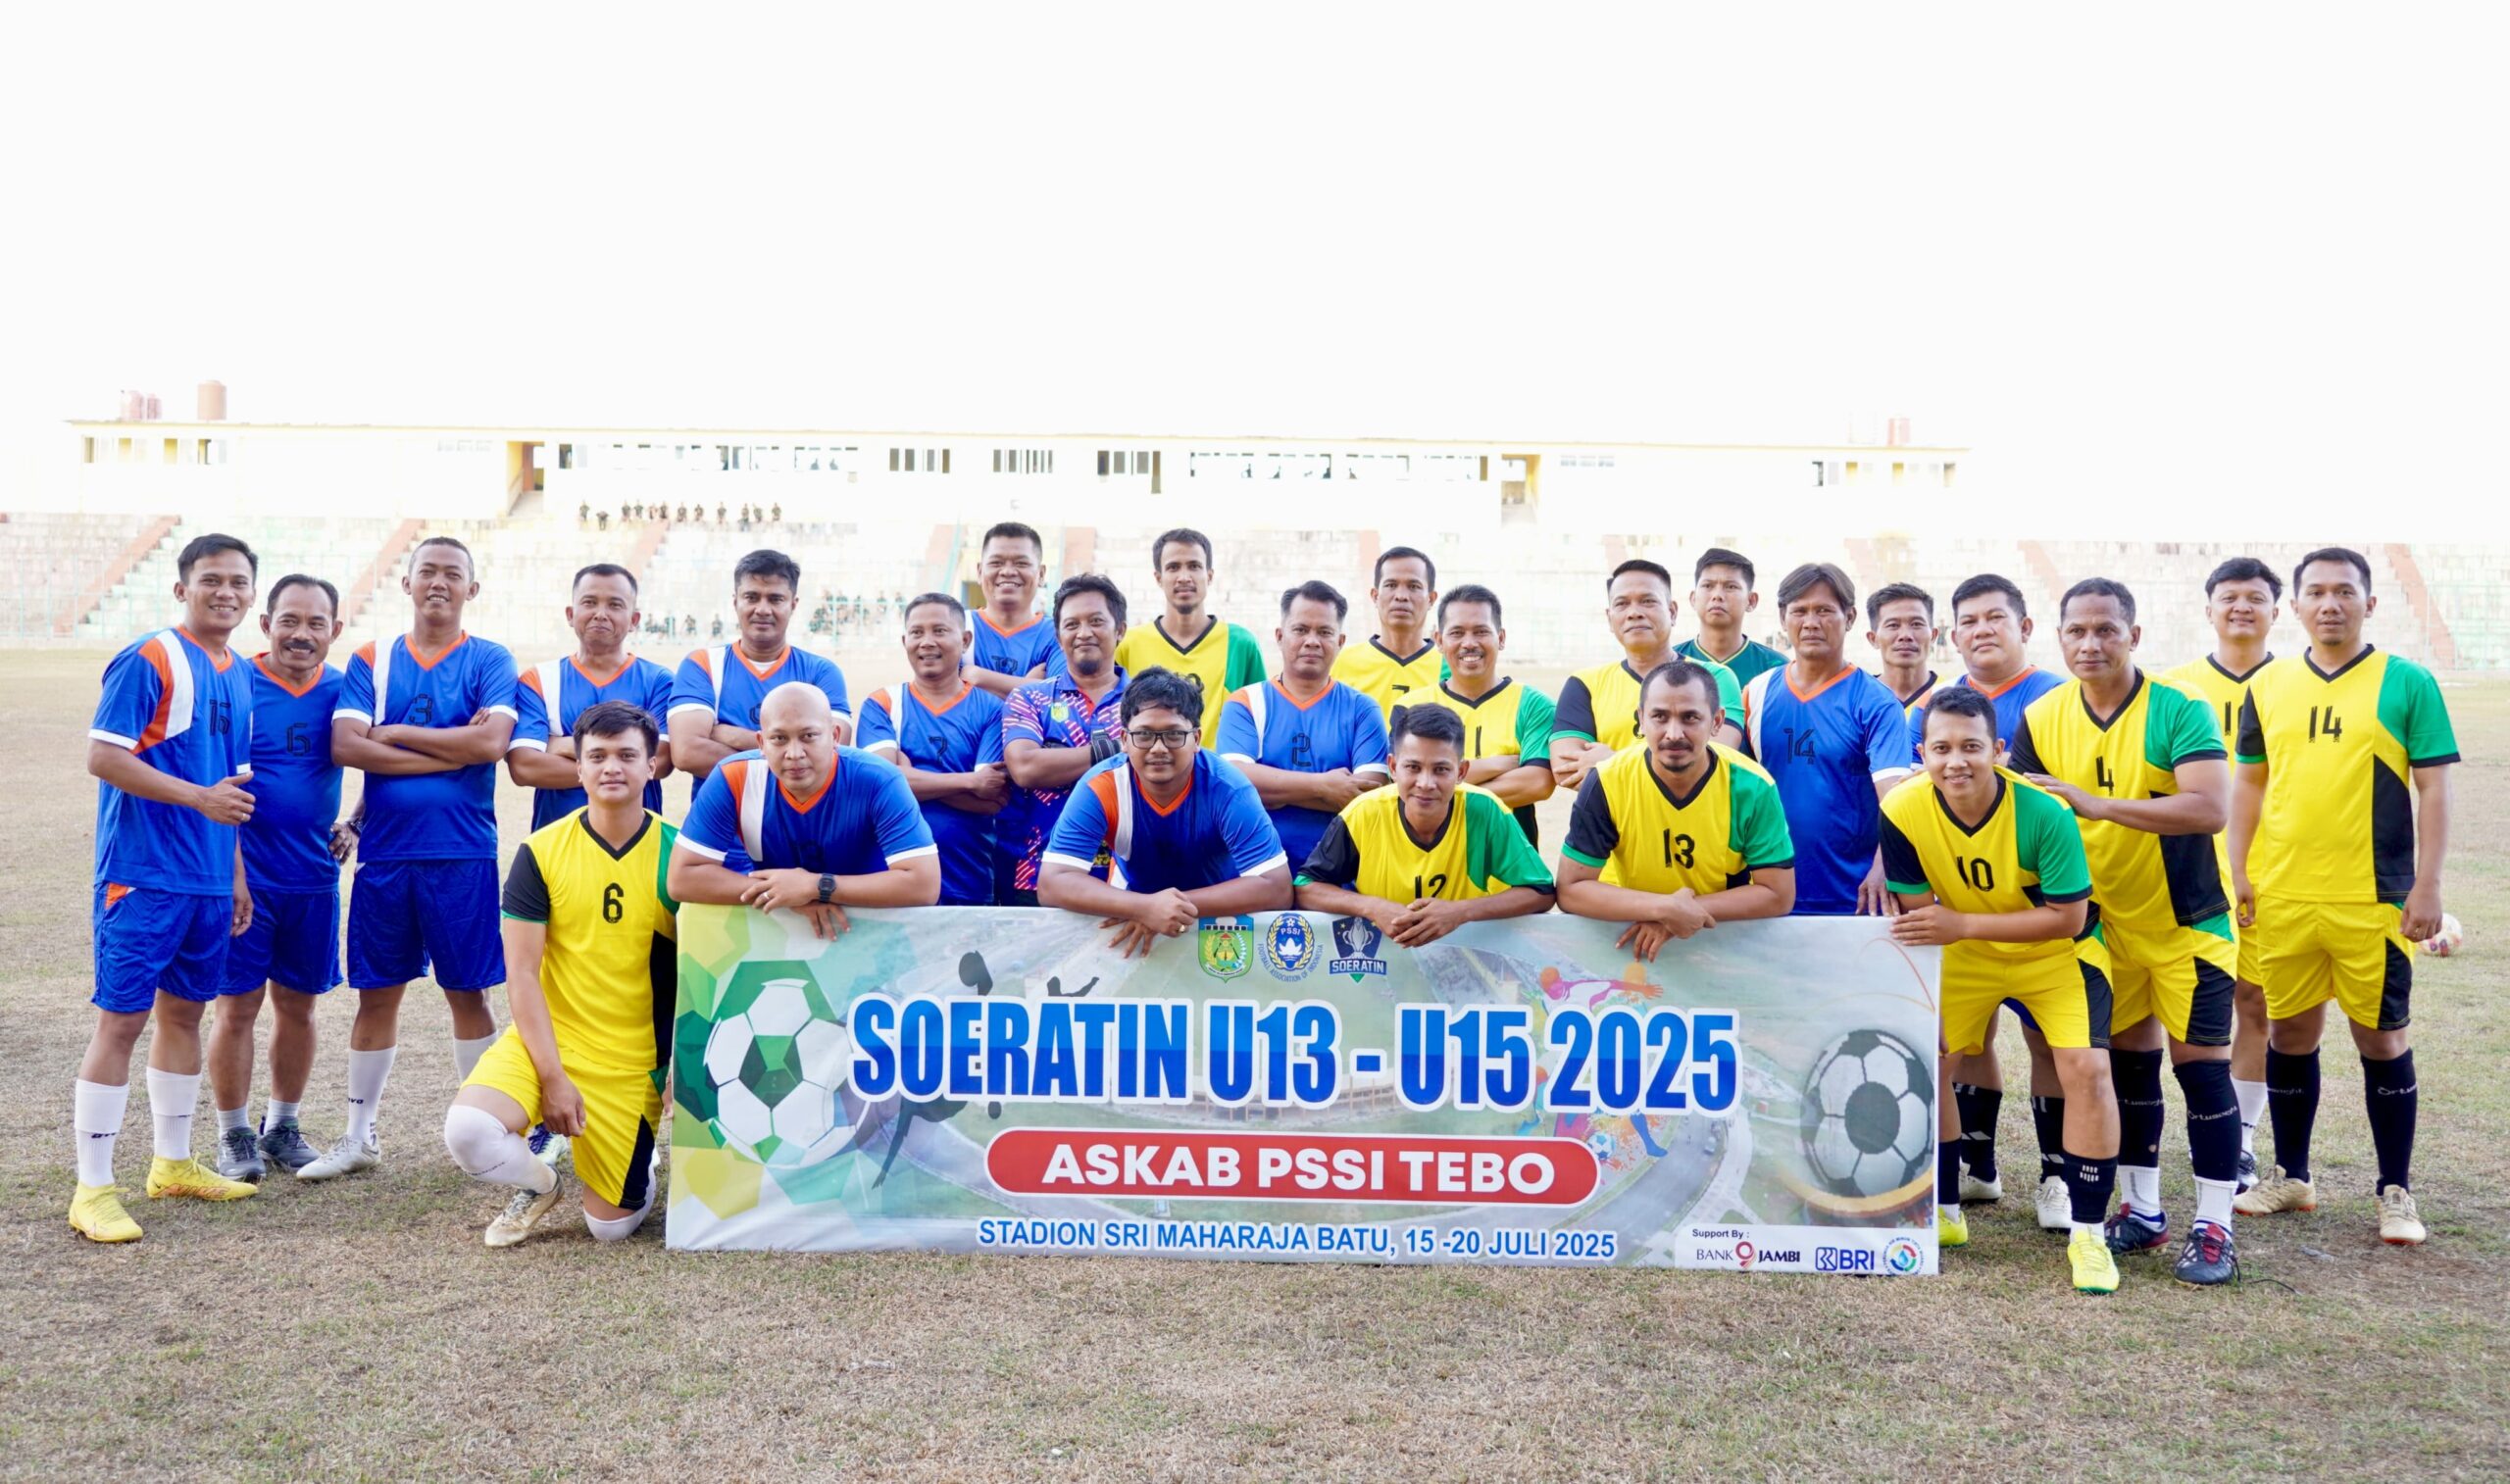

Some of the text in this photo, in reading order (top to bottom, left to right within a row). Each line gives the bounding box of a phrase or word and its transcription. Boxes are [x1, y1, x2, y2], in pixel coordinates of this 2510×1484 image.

[410, 693, 432, 726] 3
[2224, 700, 2244, 737] 1
[2308, 705, 2342, 744] 14
[286, 722, 310, 756] 6
[929, 735, 948, 763] 7
[1291, 732, 1312, 767] 2
[1782, 727, 1817, 766] 14
[2095, 755, 2115, 797] 4
[1663, 828, 1695, 869] 13
[1414, 873, 1446, 899] 12
[1956, 855, 1995, 893] 10
[603, 881, 625, 924] 6
[1280, 926, 1300, 936] PSSI
[1332, 961, 1384, 974] SOERATIN
[853, 999, 1736, 1112] SOERATIN U13 - U15 2025
[1041, 1143, 1555, 1194] ASKAB PSSI TEBO
[979, 1219, 1095, 1246] STADION
[1104, 1223, 1147, 1247] SRI
[1157, 1225, 1309, 1250] MAHARAJA
[1317, 1227, 1396, 1257] BATU,
[1405, 1229, 1433, 1253] 15
[1488, 1231, 1546, 1256] JULI
[1555, 1233, 1615, 1258] 2025
[1692, 1228, 1729, 1239] Support
[1732, 1229, 1743, 1239] By
[1696, 1249, 1733, 1261] BANK
[1758, 1250, 1800, 1262] JAMBI
[1839, 1249, 1875, 1270] BRI
